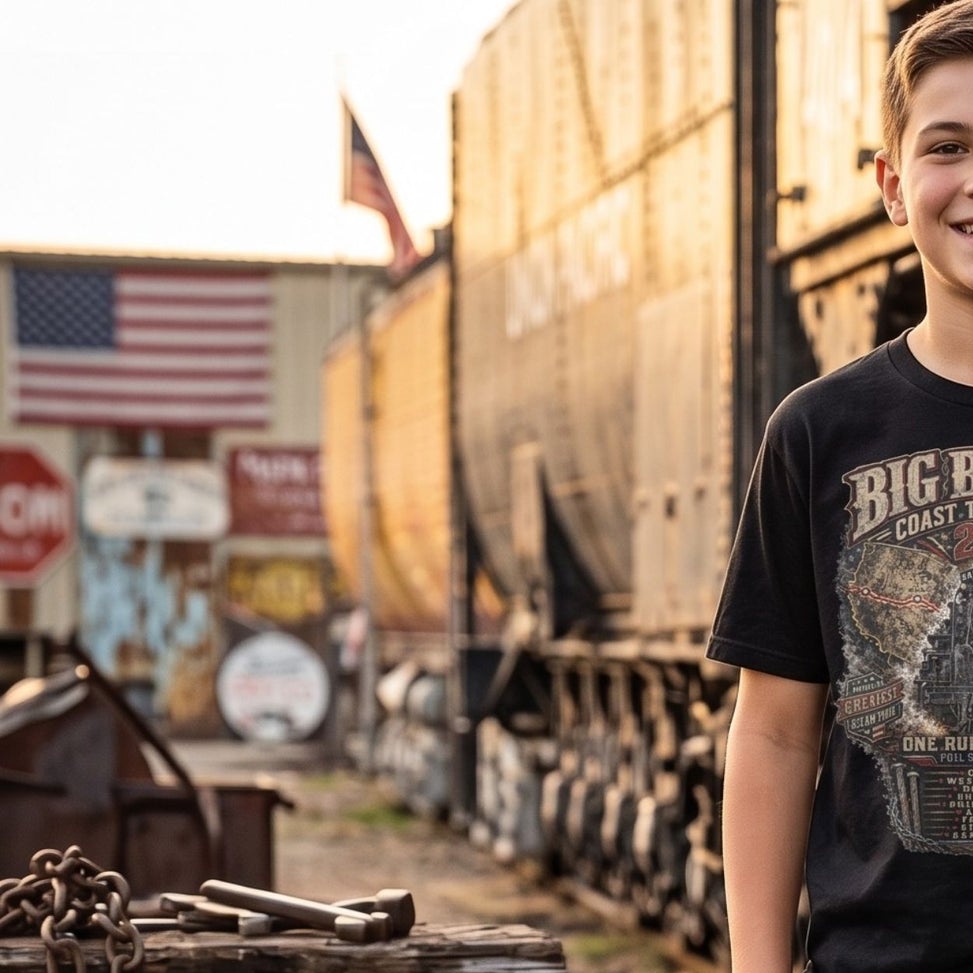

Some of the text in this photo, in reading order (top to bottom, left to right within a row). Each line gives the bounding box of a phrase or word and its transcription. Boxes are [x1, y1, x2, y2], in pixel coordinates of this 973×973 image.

[849, 451, 941, 538] BIG
[895, 501, 957, 541] COAST
[902, 736, 938, 752] ONE
